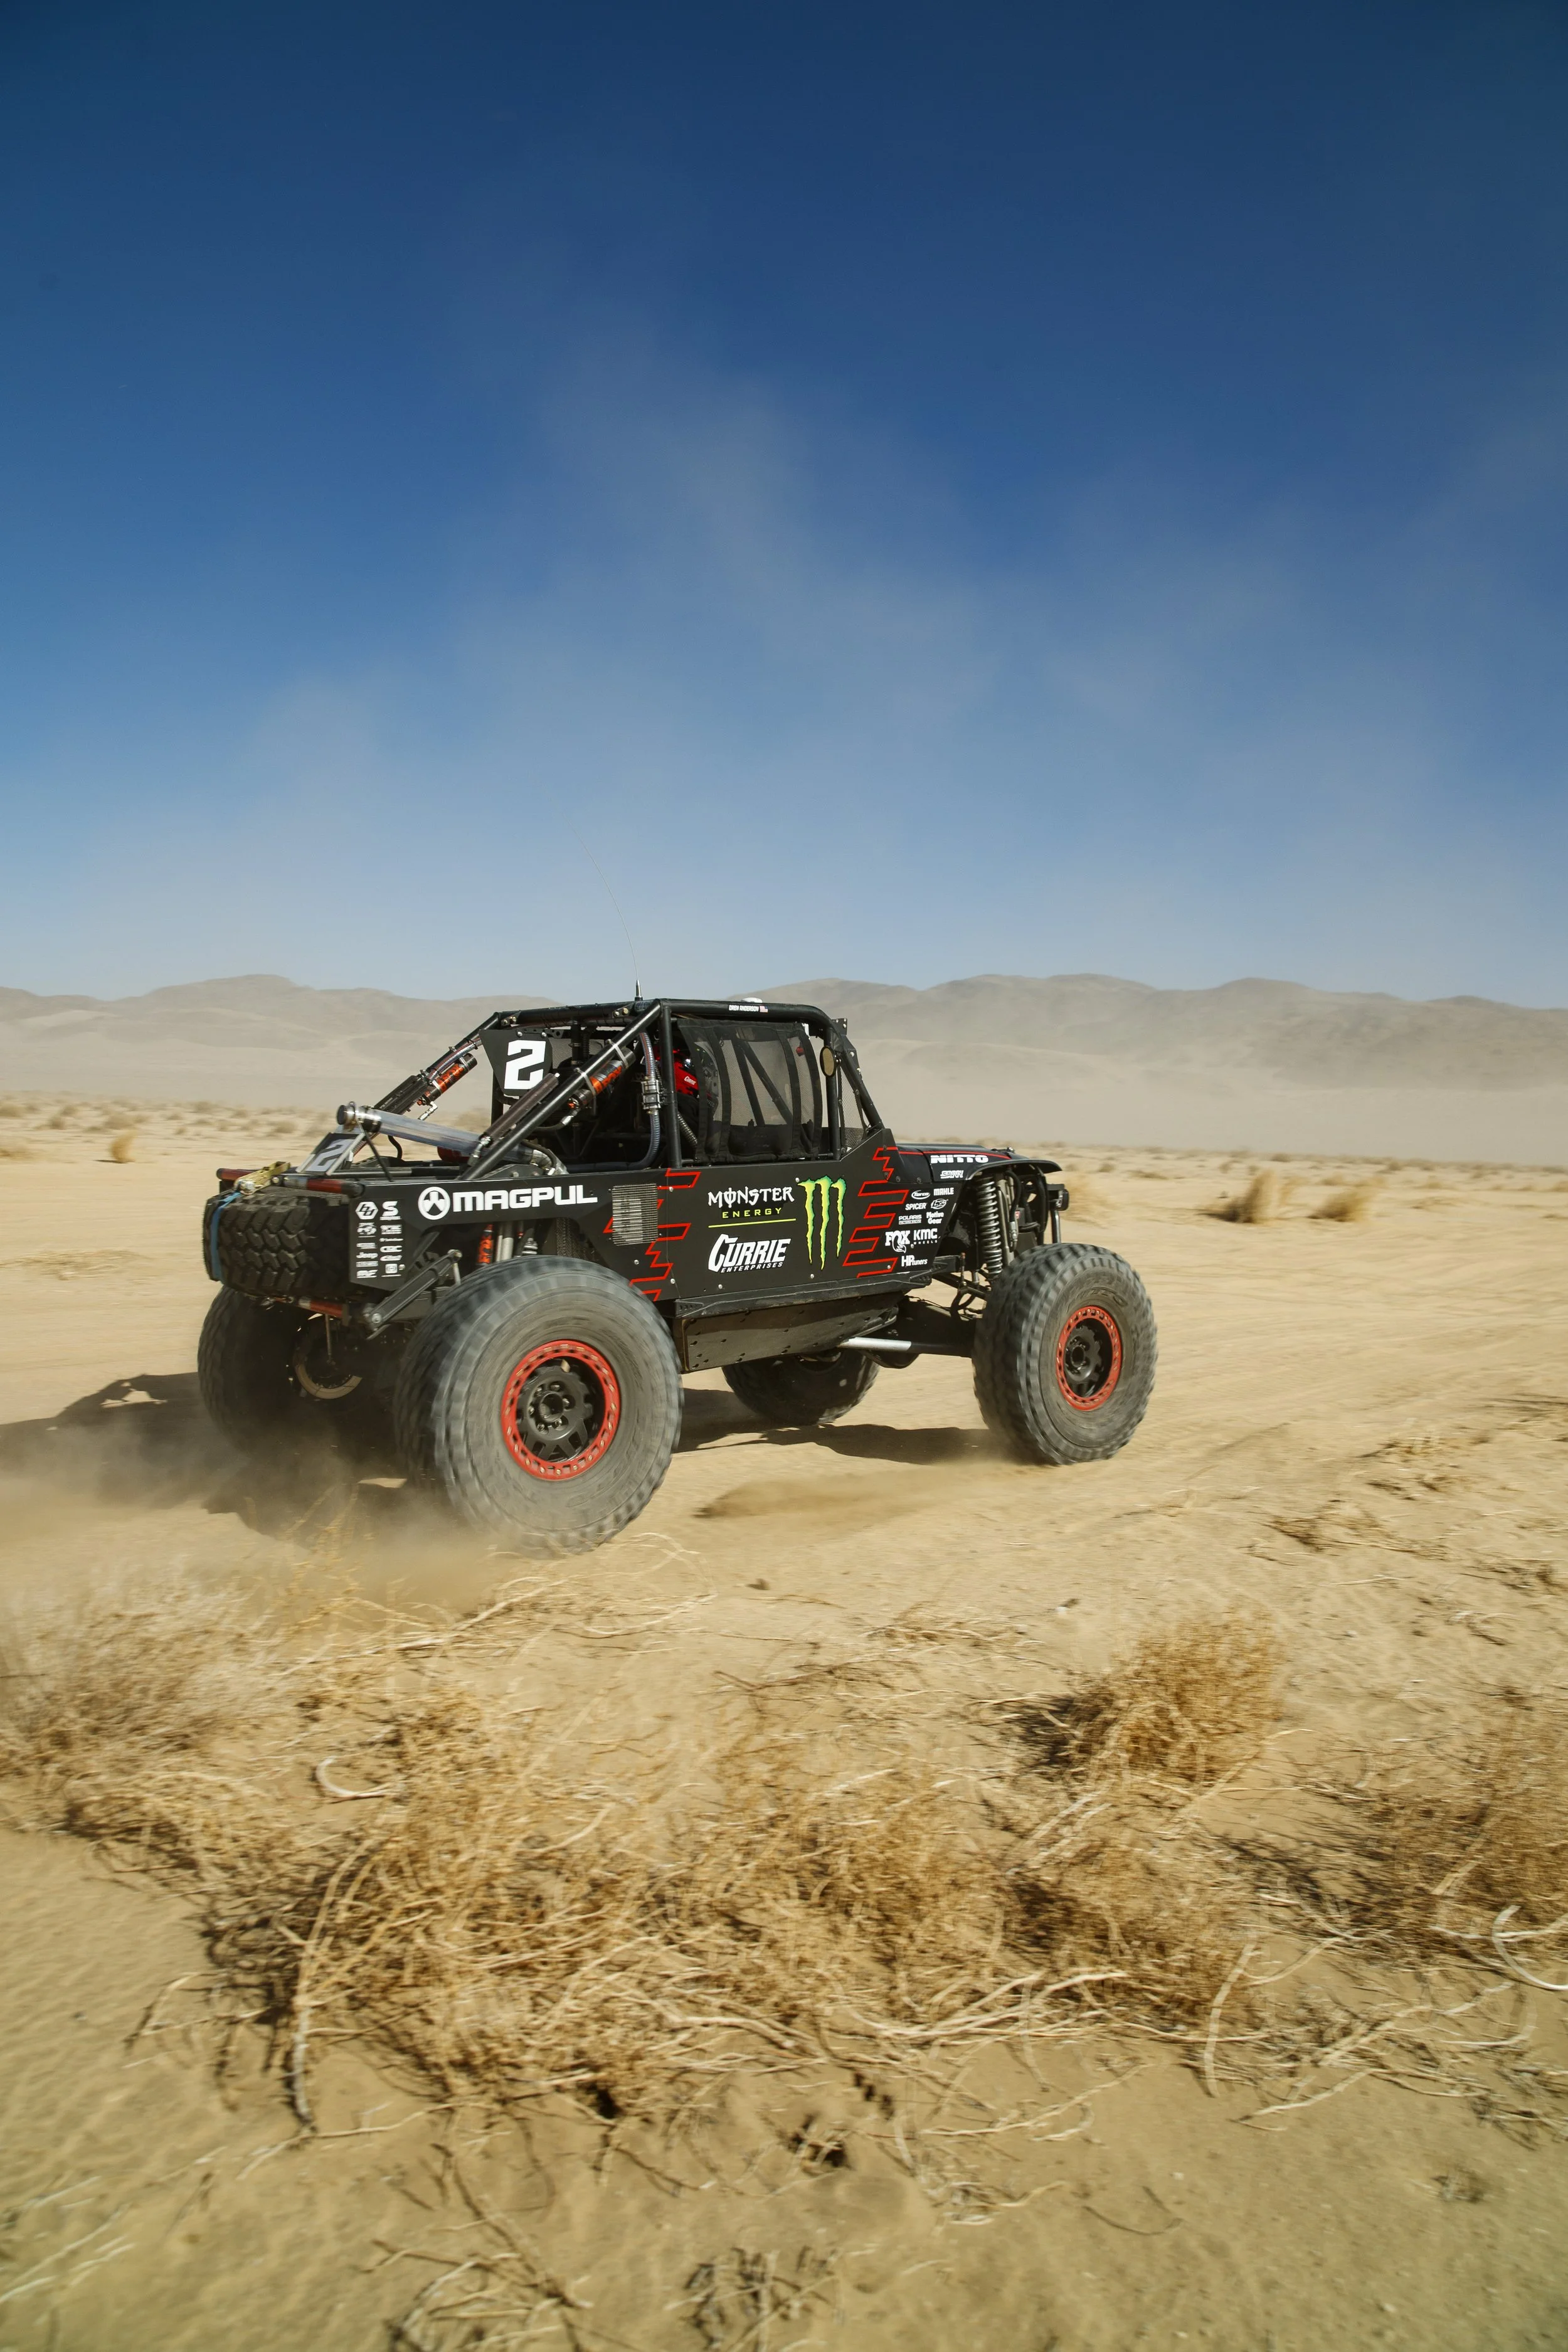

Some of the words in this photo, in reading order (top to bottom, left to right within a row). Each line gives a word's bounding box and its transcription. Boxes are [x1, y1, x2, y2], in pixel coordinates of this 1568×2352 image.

[504, 1040, 546, 1089] 2
[305, 1139, 355, 1172] 2
[930, 1155, 988, 1163] NITTO
[453, 1185, 598, 1212] MAGPUL
[707, 1186, 795, 1208] MONSTER
[933, 1187, 954, 1196] MAHLE
[722, 1207, 782, 1219] ENERGY
[905, 1202, 927, 1210] SPICER
[885, 1230, 911, 1253] FOX
[913, 1228, 938, 1241] KMC
[708, 1234, 791, 1272] CURRIE
[721, 1261, 783, 1273] ENTERPRISES
